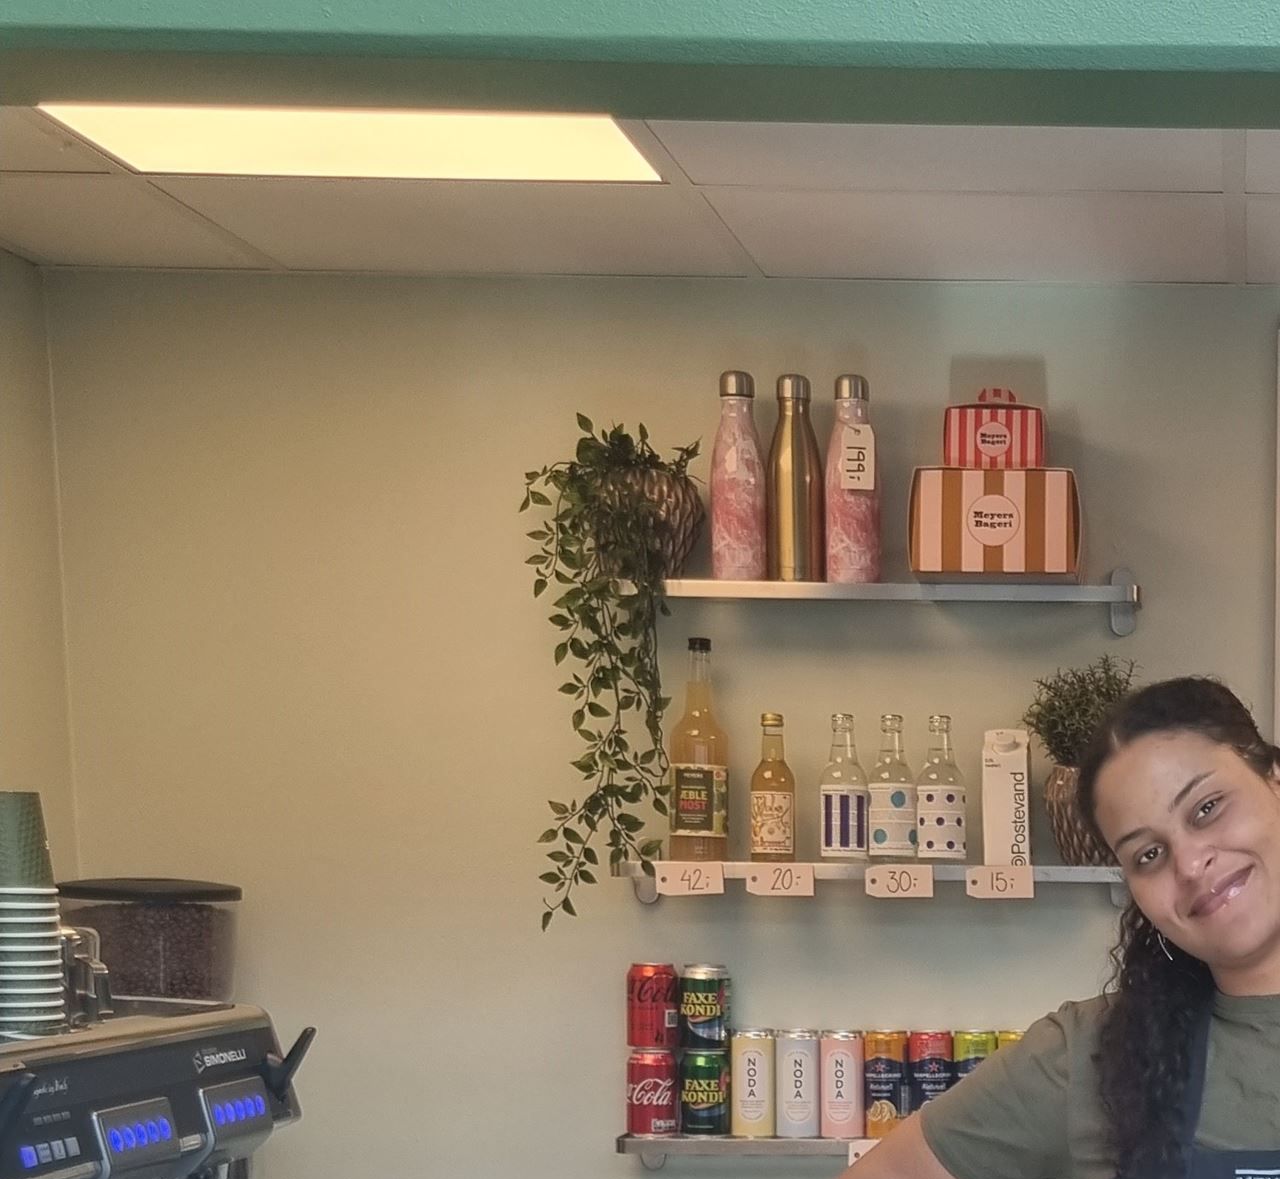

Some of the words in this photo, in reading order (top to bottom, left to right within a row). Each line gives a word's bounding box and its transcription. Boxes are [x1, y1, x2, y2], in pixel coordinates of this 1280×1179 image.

[973, 511, 1014, 520] Meyers
[975, 520, 1012, 528] Bageri
[683, 992, 718, 1005] FAXE
[681, 1004, 721, 1017] KONDI
[204, 1048, 248, 1067] SIMONELLI
[747, 1058, 756, 1099] NODA
[794, 1058, 804, 1099] NODA
[835, 1058, 844, 1099] NODA
[685, 1079, 719, 1092] FAXE
[682, 1091, 724, 1103] KONDI
